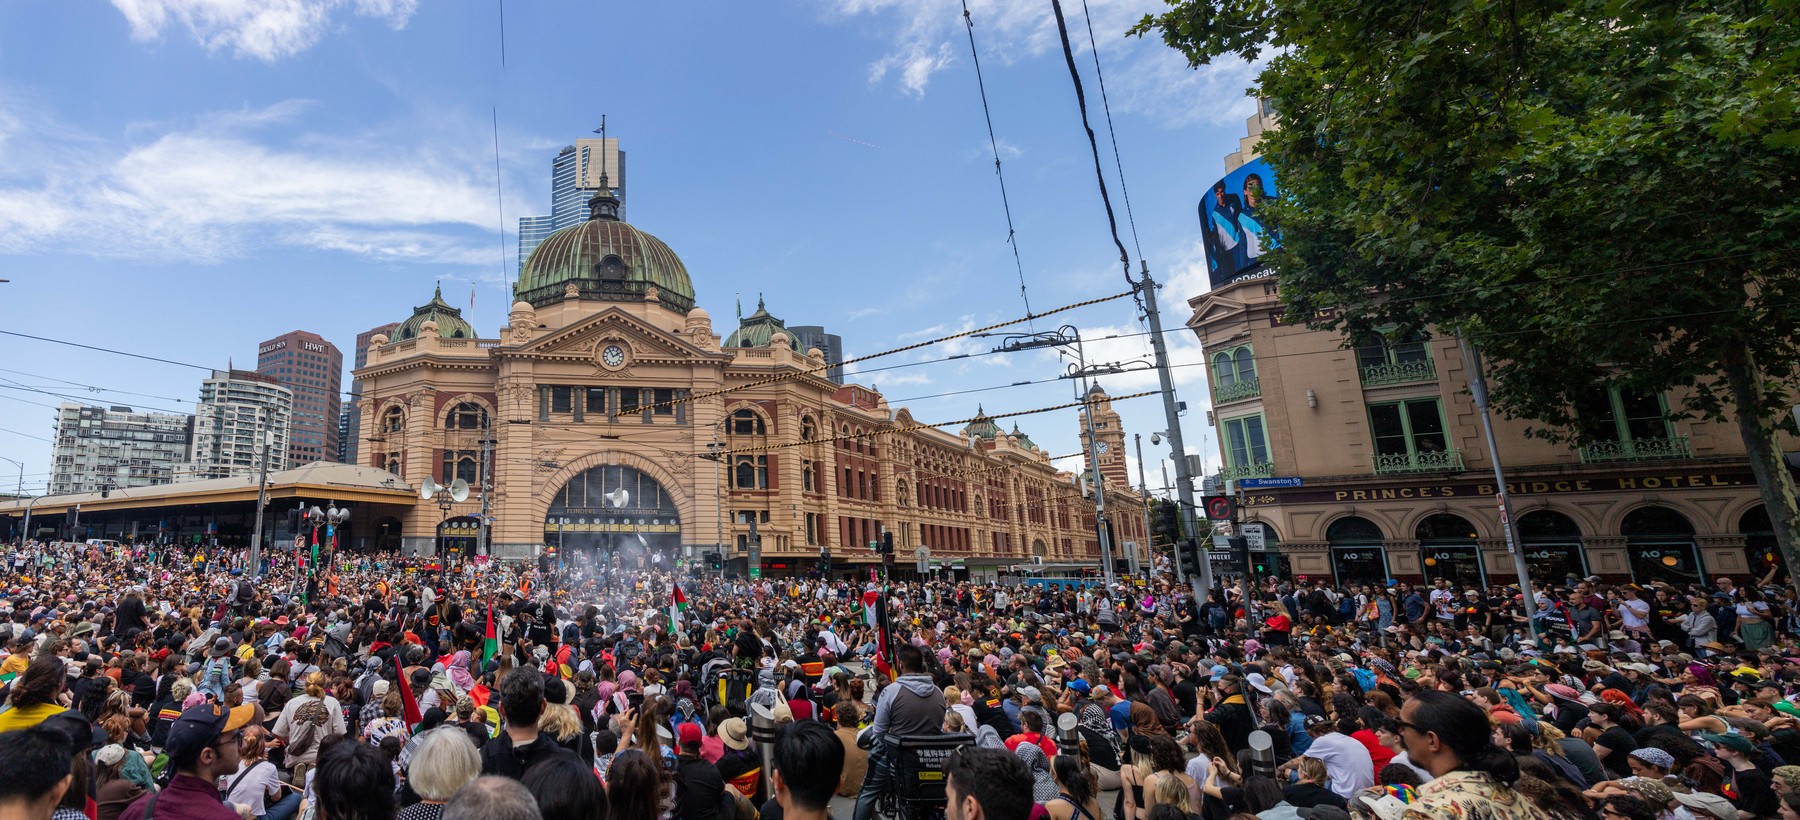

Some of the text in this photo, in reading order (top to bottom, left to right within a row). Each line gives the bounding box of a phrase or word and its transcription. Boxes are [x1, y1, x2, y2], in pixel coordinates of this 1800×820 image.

[305, 342, 324, 353] HWT
[1335, 486, 1454, 500] PRINCE'S
[1478, 479, 1592, 495] BRIDGE
